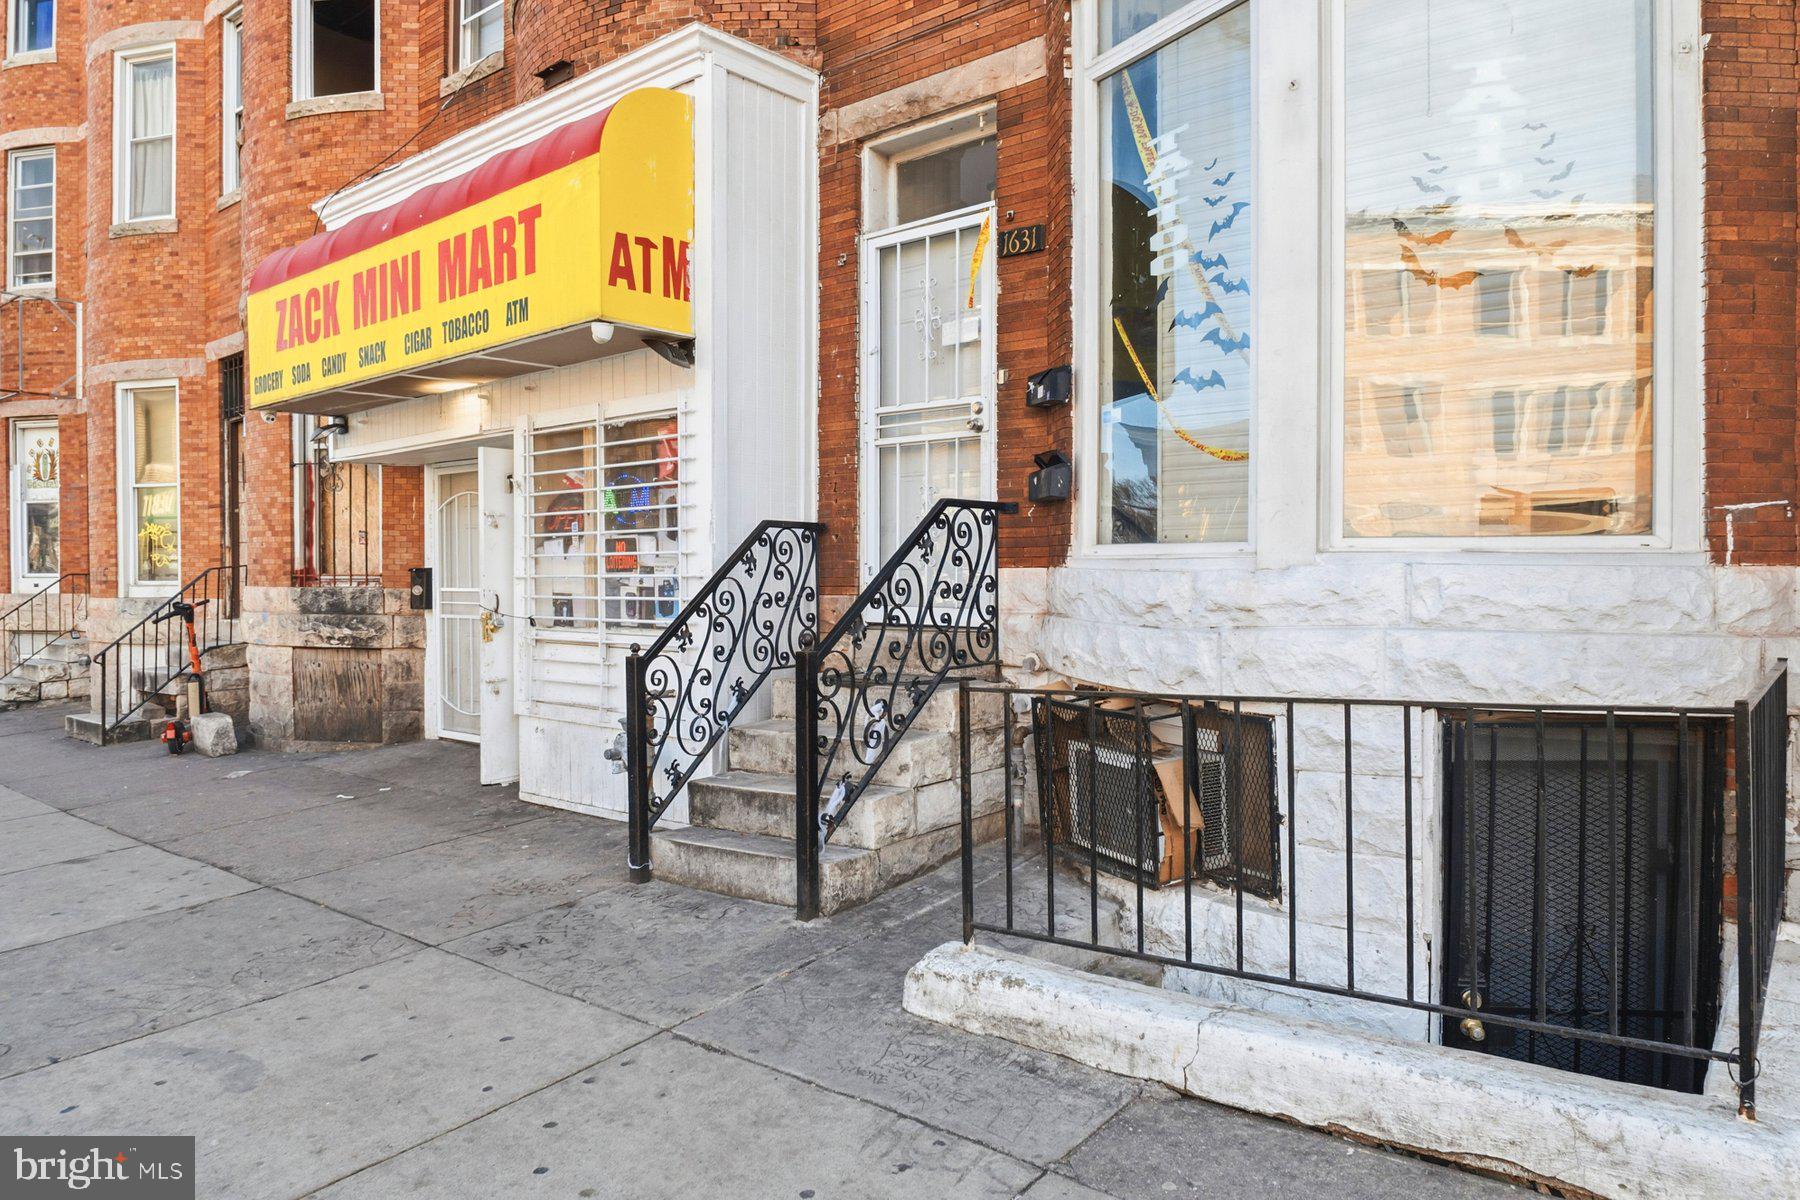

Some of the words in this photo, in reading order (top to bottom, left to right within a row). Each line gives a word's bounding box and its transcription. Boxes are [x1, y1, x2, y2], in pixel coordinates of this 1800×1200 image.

[608, 231, 690, 302] ATM
[1003, 227, 1036, 256] 1631
[275, 280, 341, 353] ZACK
[353, 249, 421, 330] MINI
[438, 203, 542, 303] MART
[254, 369, 284, 396] GROCERY
[291, 362, 312, 386] SODA
[321, 352, 347, 378] CANDY
[358, 340, 387, 369] SNACK
[404, 326, 433, 356] CIGAR
[442, 308, 490, 344] TOBACCO
[506, 296, 529, 327] ATM
[615, 540, 626, 554] NO
